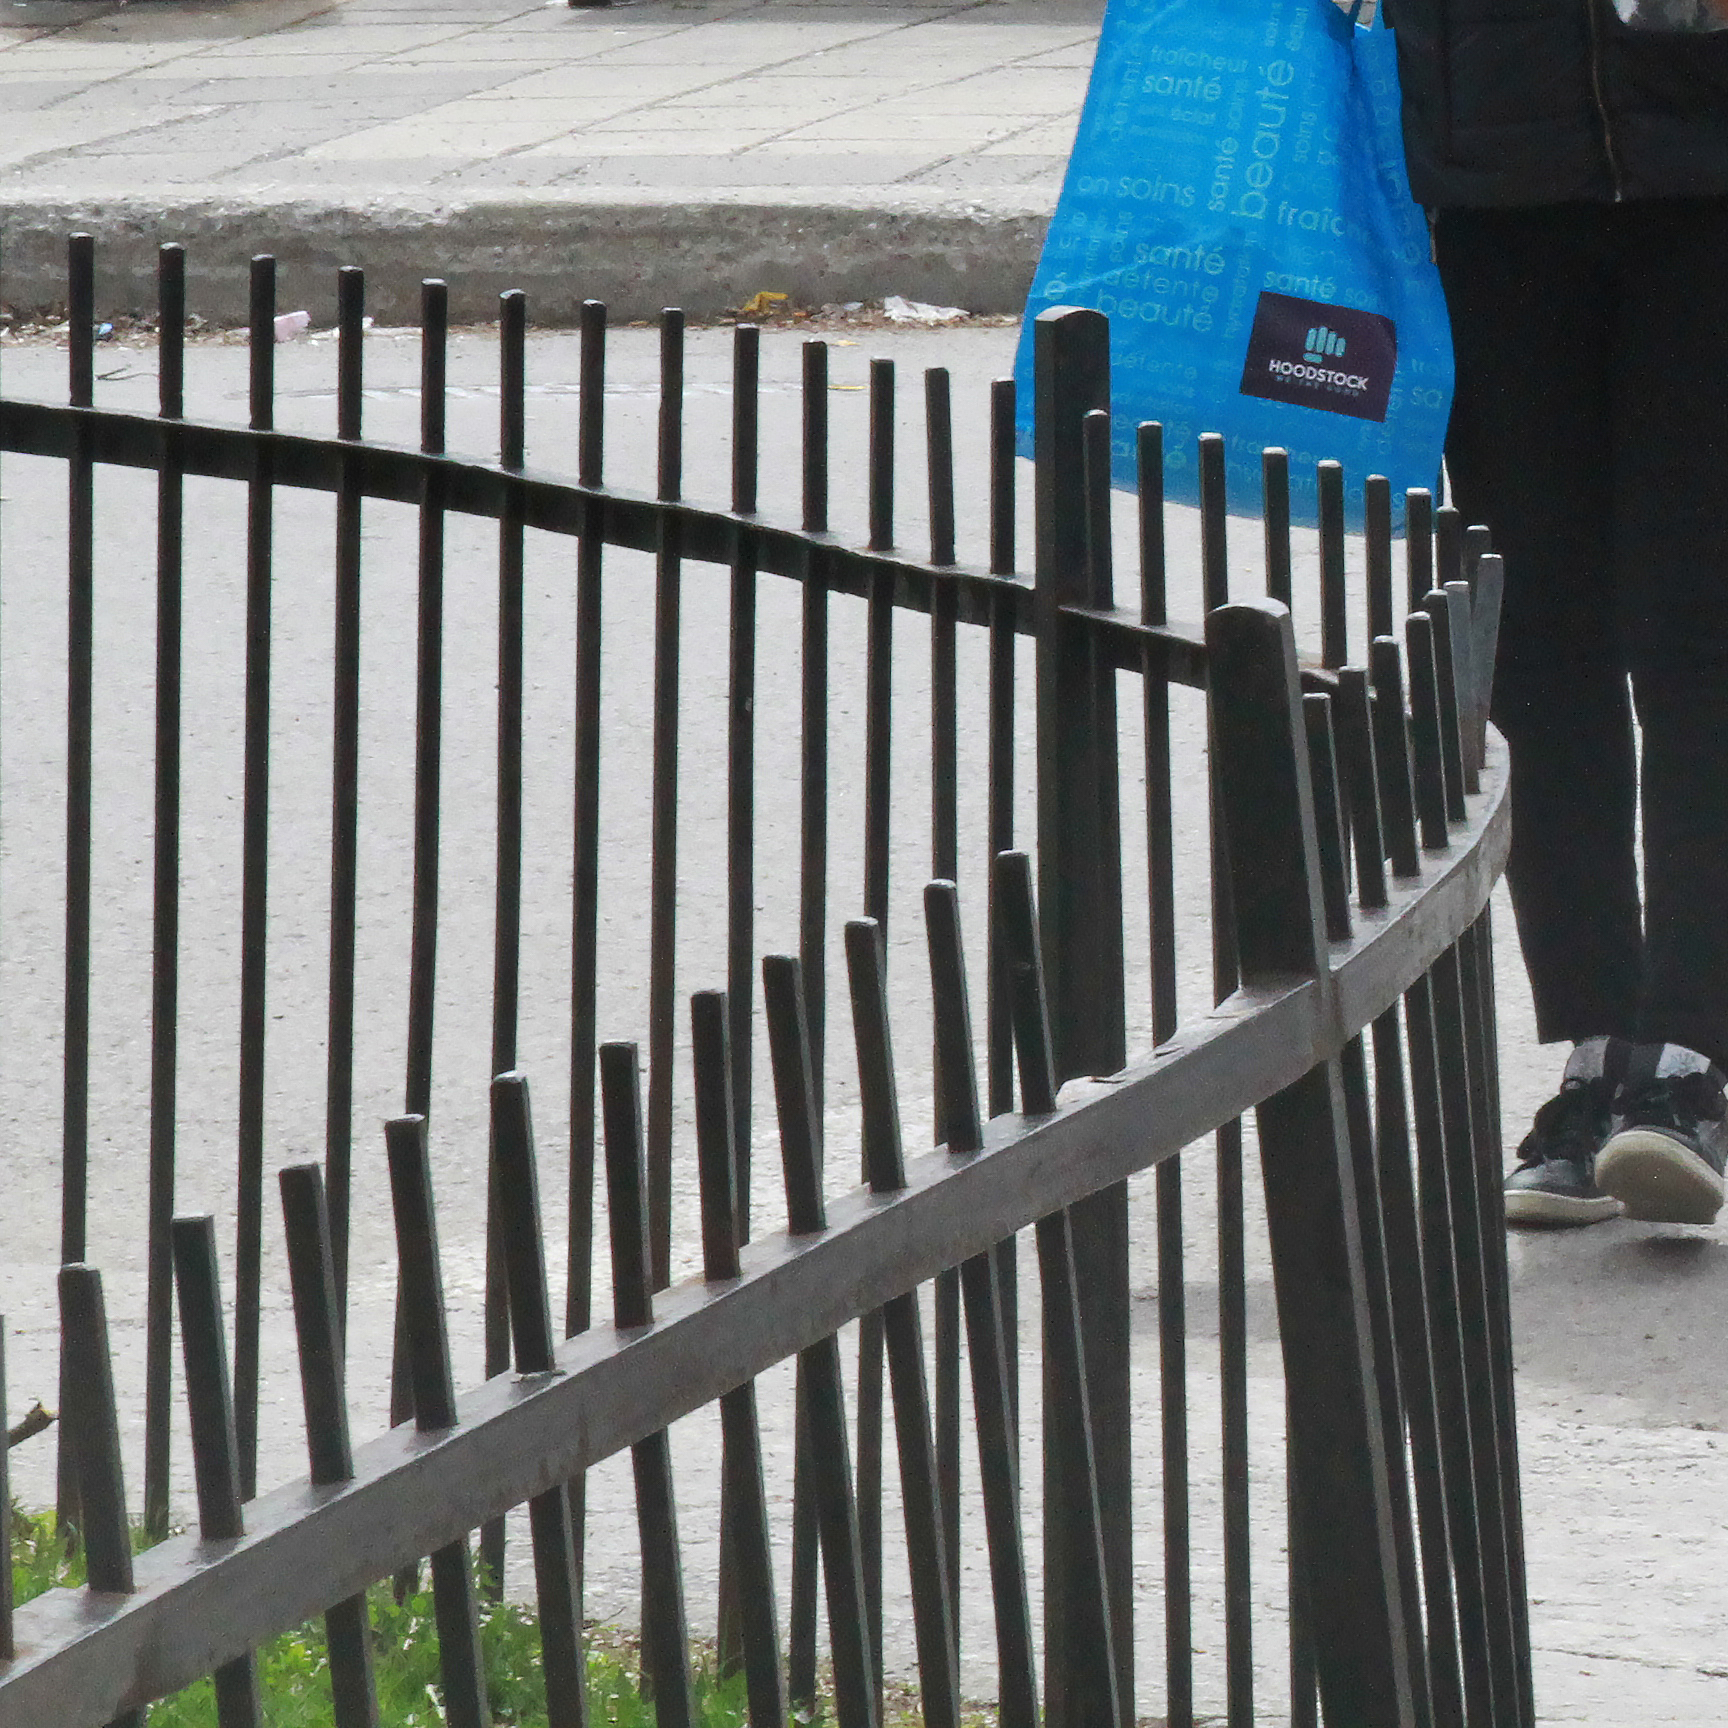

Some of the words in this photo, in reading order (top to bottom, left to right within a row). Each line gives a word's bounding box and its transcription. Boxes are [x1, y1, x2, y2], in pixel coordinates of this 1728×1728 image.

[1142, 74, 1222, 103] santé
[1231, 58, 1295, 220] beauté
[1115, 173, 1197, 208] soins
[1208, 136, 1240, 213] santé
[1134, 242, 1226, 276] santé
[1263, 270, 1338, 299] santé
[1098, 287, 1214, 333] beauté
[1268, 358, 1370, 391] HOODSTOCK
